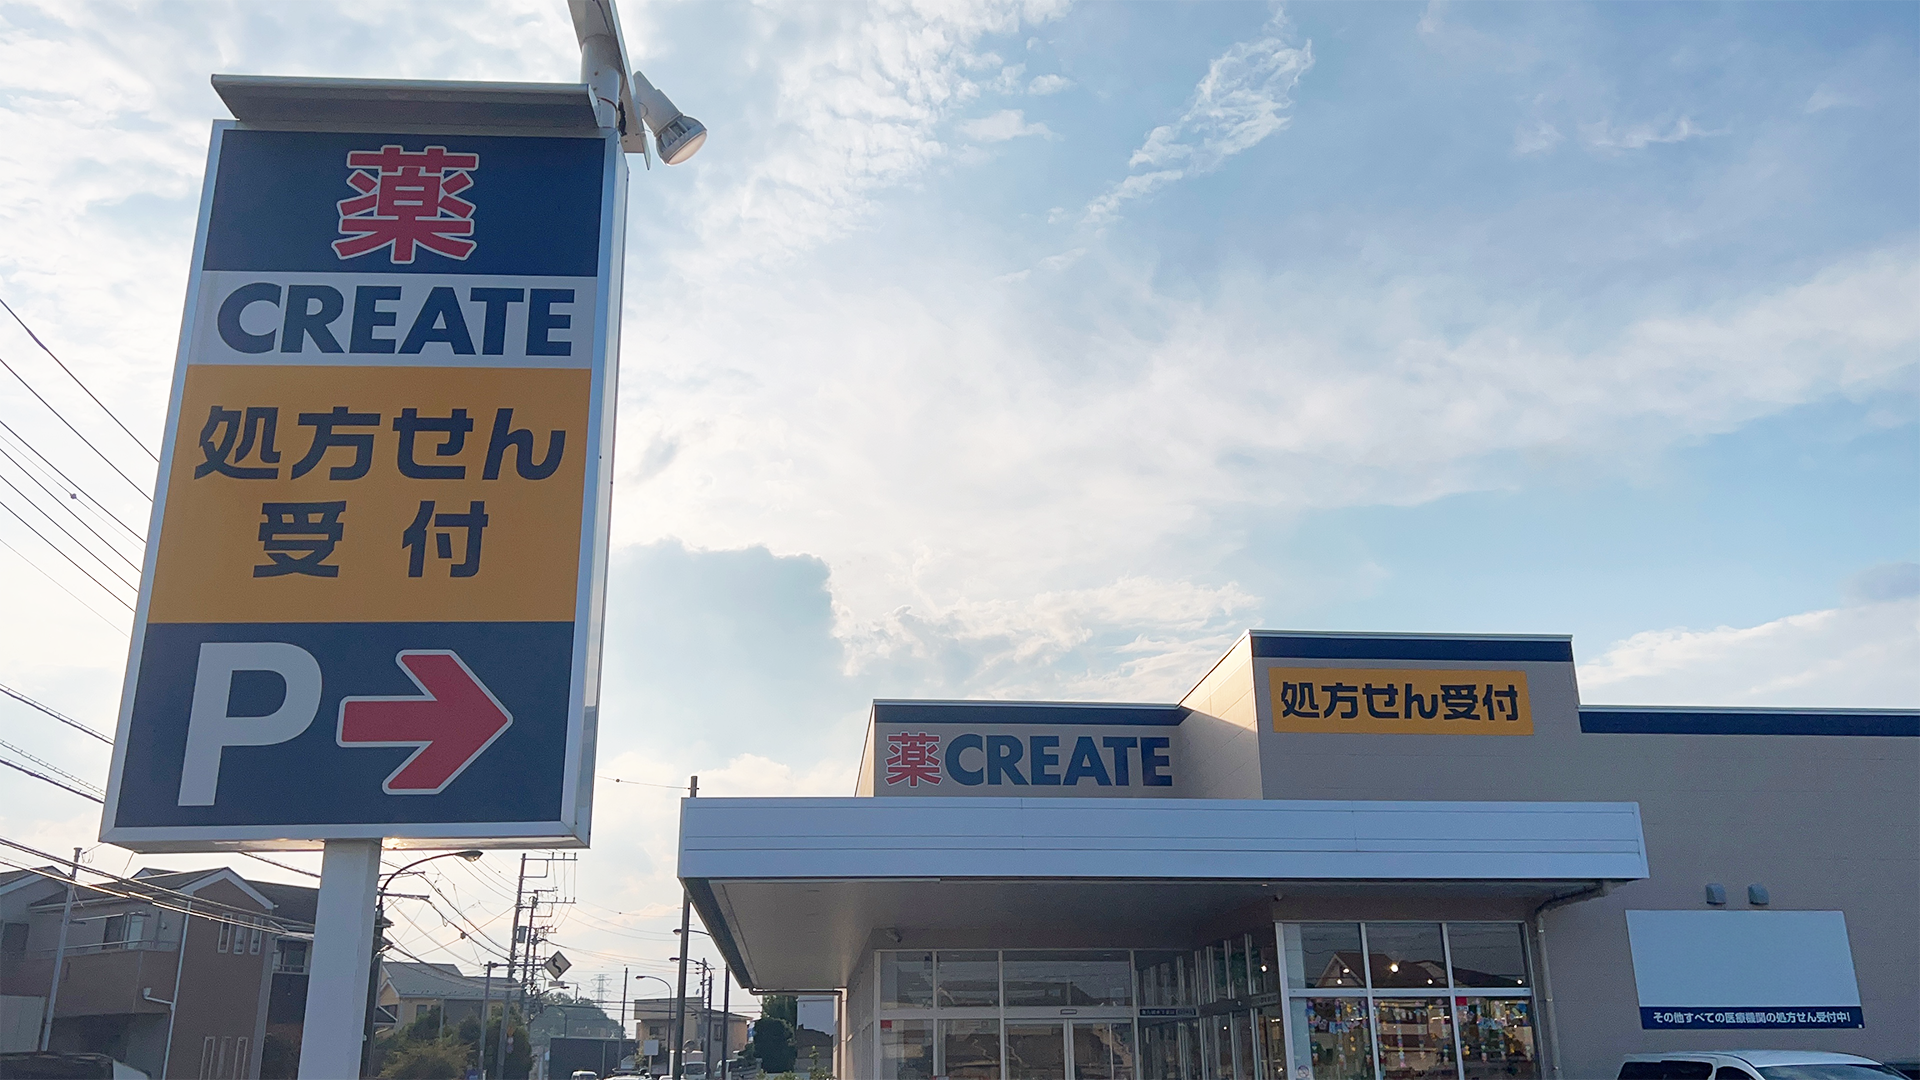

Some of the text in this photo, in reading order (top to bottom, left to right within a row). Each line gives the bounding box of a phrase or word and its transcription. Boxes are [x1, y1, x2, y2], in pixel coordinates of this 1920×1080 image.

[331, 145, 480, 264] 薬
[216, 281, 576, 357] CREATE
[193, 405, 567, 482] 処方せん
[177, 642, 323, 806] P
[1280, 681, 1519, 722] 処方せん受付
[884, 731, 1173, 788] 薬 CREATE
